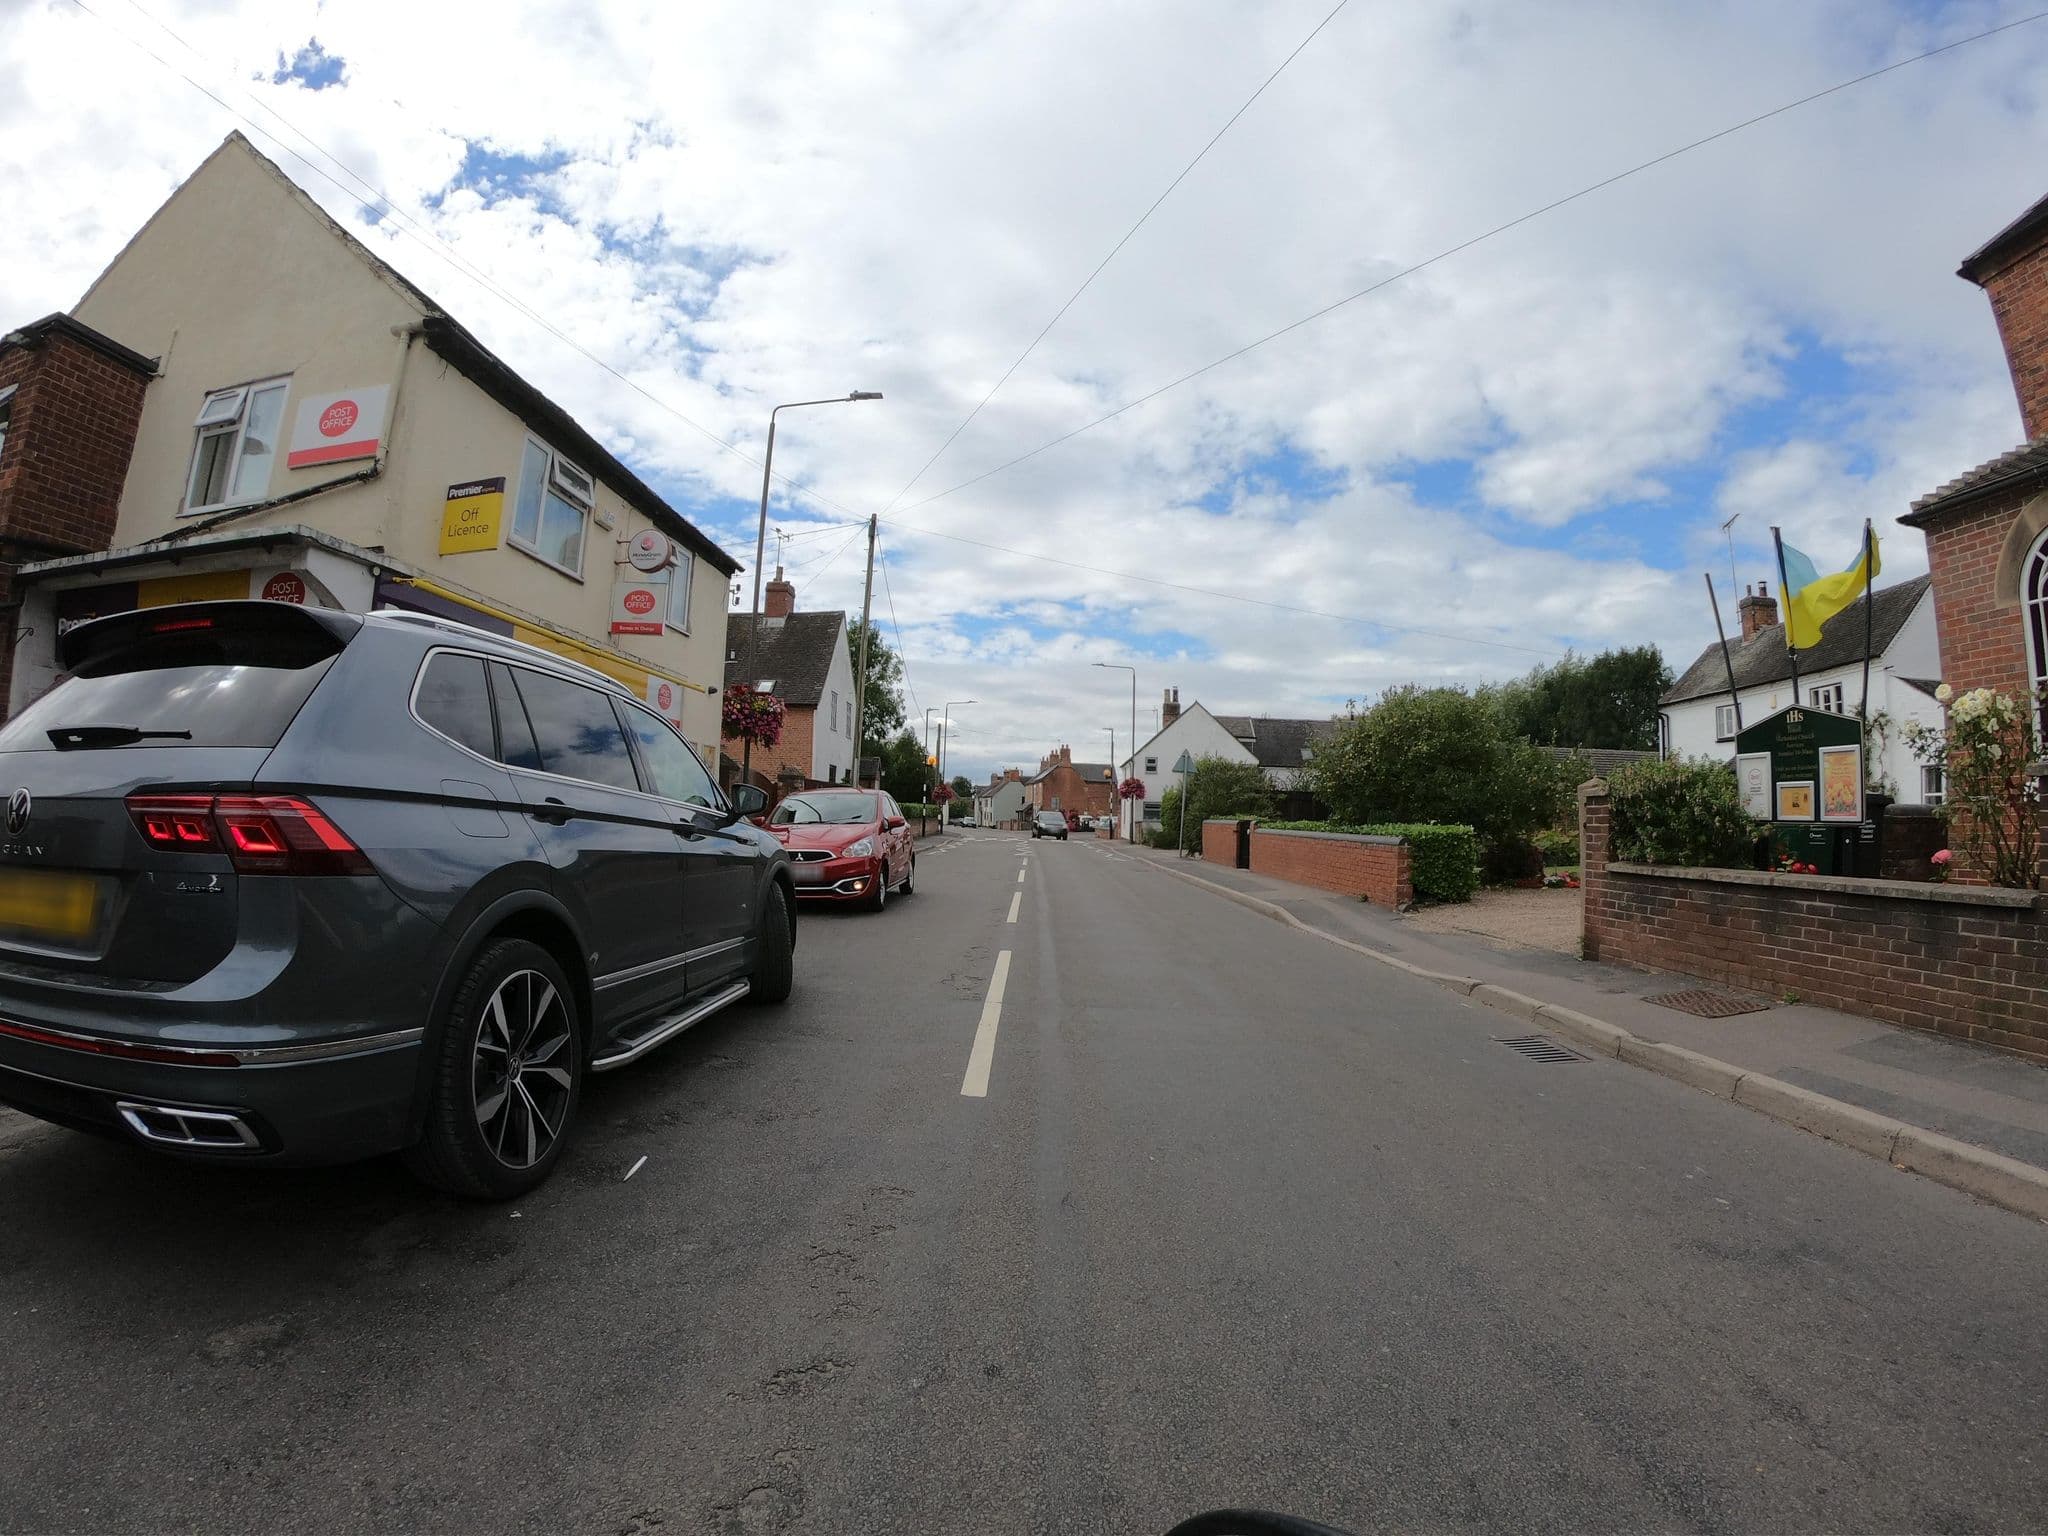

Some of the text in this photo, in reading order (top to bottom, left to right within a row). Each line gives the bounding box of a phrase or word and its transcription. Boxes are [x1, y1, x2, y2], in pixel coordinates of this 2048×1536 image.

[329, 406, 352, 418] POST
[321, 416, 353, 430] OFFICE
[448, 485, 483, 498] Premier
[461, 507, 480, 522] Off
[448, 524, 489, 538] Licence
[272, 581, 297, 595] POST
[631, 594, 649, 602] POST
[625, 601, 651, 609] OFFICE
